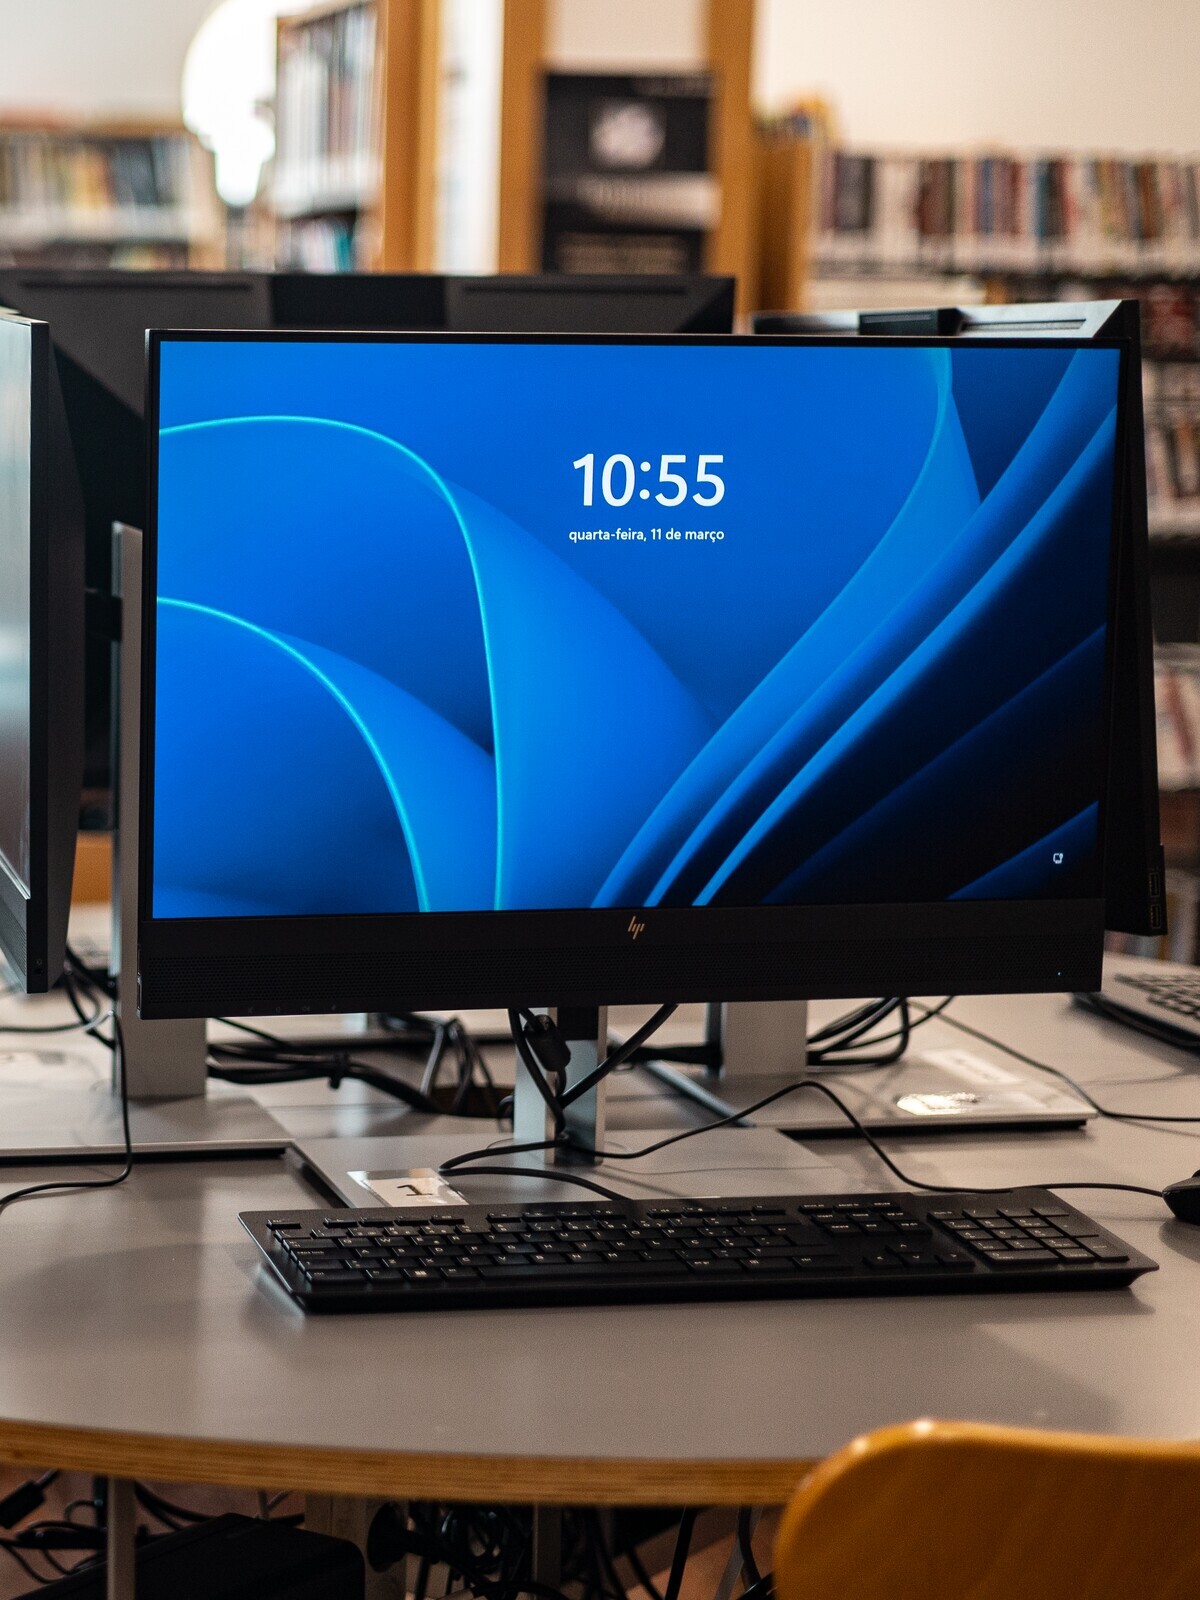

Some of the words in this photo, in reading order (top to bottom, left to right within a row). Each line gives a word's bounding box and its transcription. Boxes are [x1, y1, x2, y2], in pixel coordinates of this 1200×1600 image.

[573, 453, 726, 507] 10:55
[568, 527, 647, 544] quarta-feira,
[651, 528, 662, 540] 11
[665, 527, 682, 540] de
[685, 529, 725, 543] março
